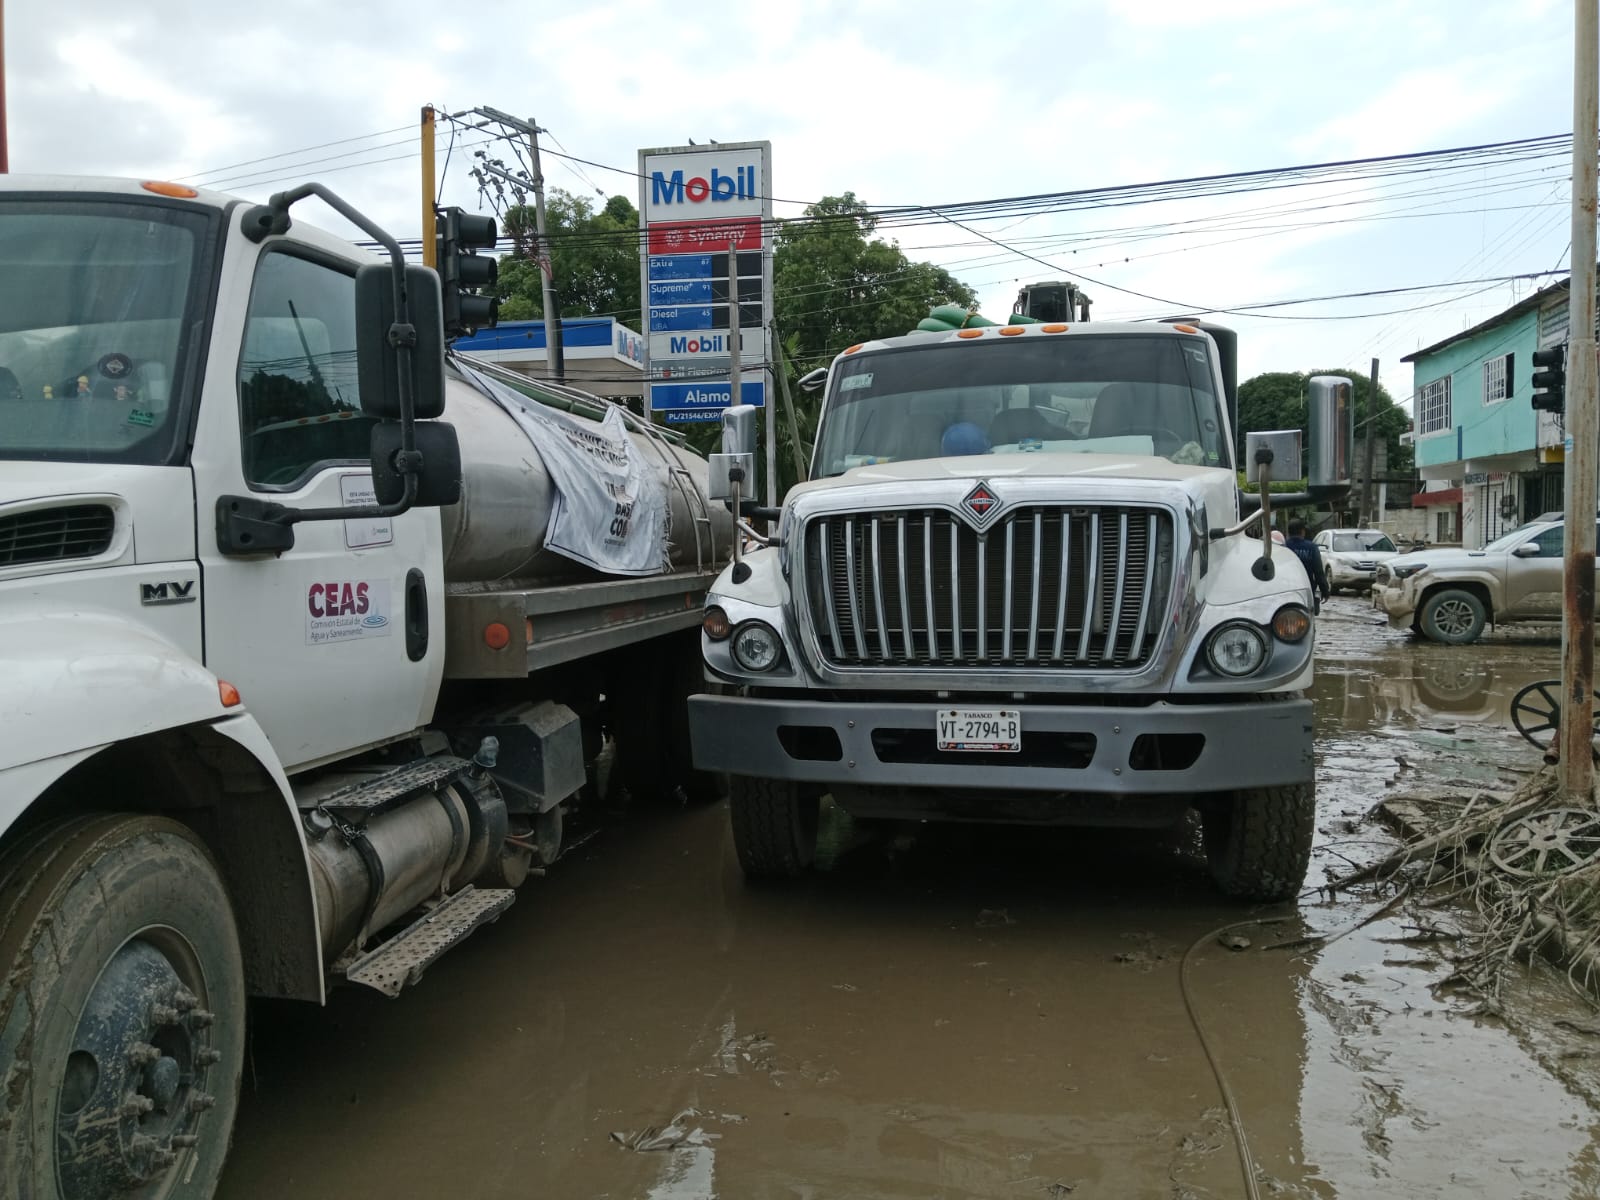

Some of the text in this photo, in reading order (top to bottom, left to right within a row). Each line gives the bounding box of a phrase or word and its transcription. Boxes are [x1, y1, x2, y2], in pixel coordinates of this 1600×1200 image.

[652, 165, 756, 205] Mobil
[688, 229, 747, 246] Synergy
[650, 258, 673, 267] Extra
[651, 309, 678, 318] Diesel
[670, 335, 722, 354] Mobil
[652, 366, 685, 378] Mobil
[684, 389, 731, 404] Alamo
[668, 411, 723, 421] PL/21546/EXP/
[143, 580, 195, 600] MV
[308, 582, 370, 618] CEAS
[311, 615, 361, 629] Comisión Estatal de
[311, 631, 326, 642] Agua
[330, 627, 363, 638] Saneamiento
[940, 720, 1017, 739] VT-2794-B
